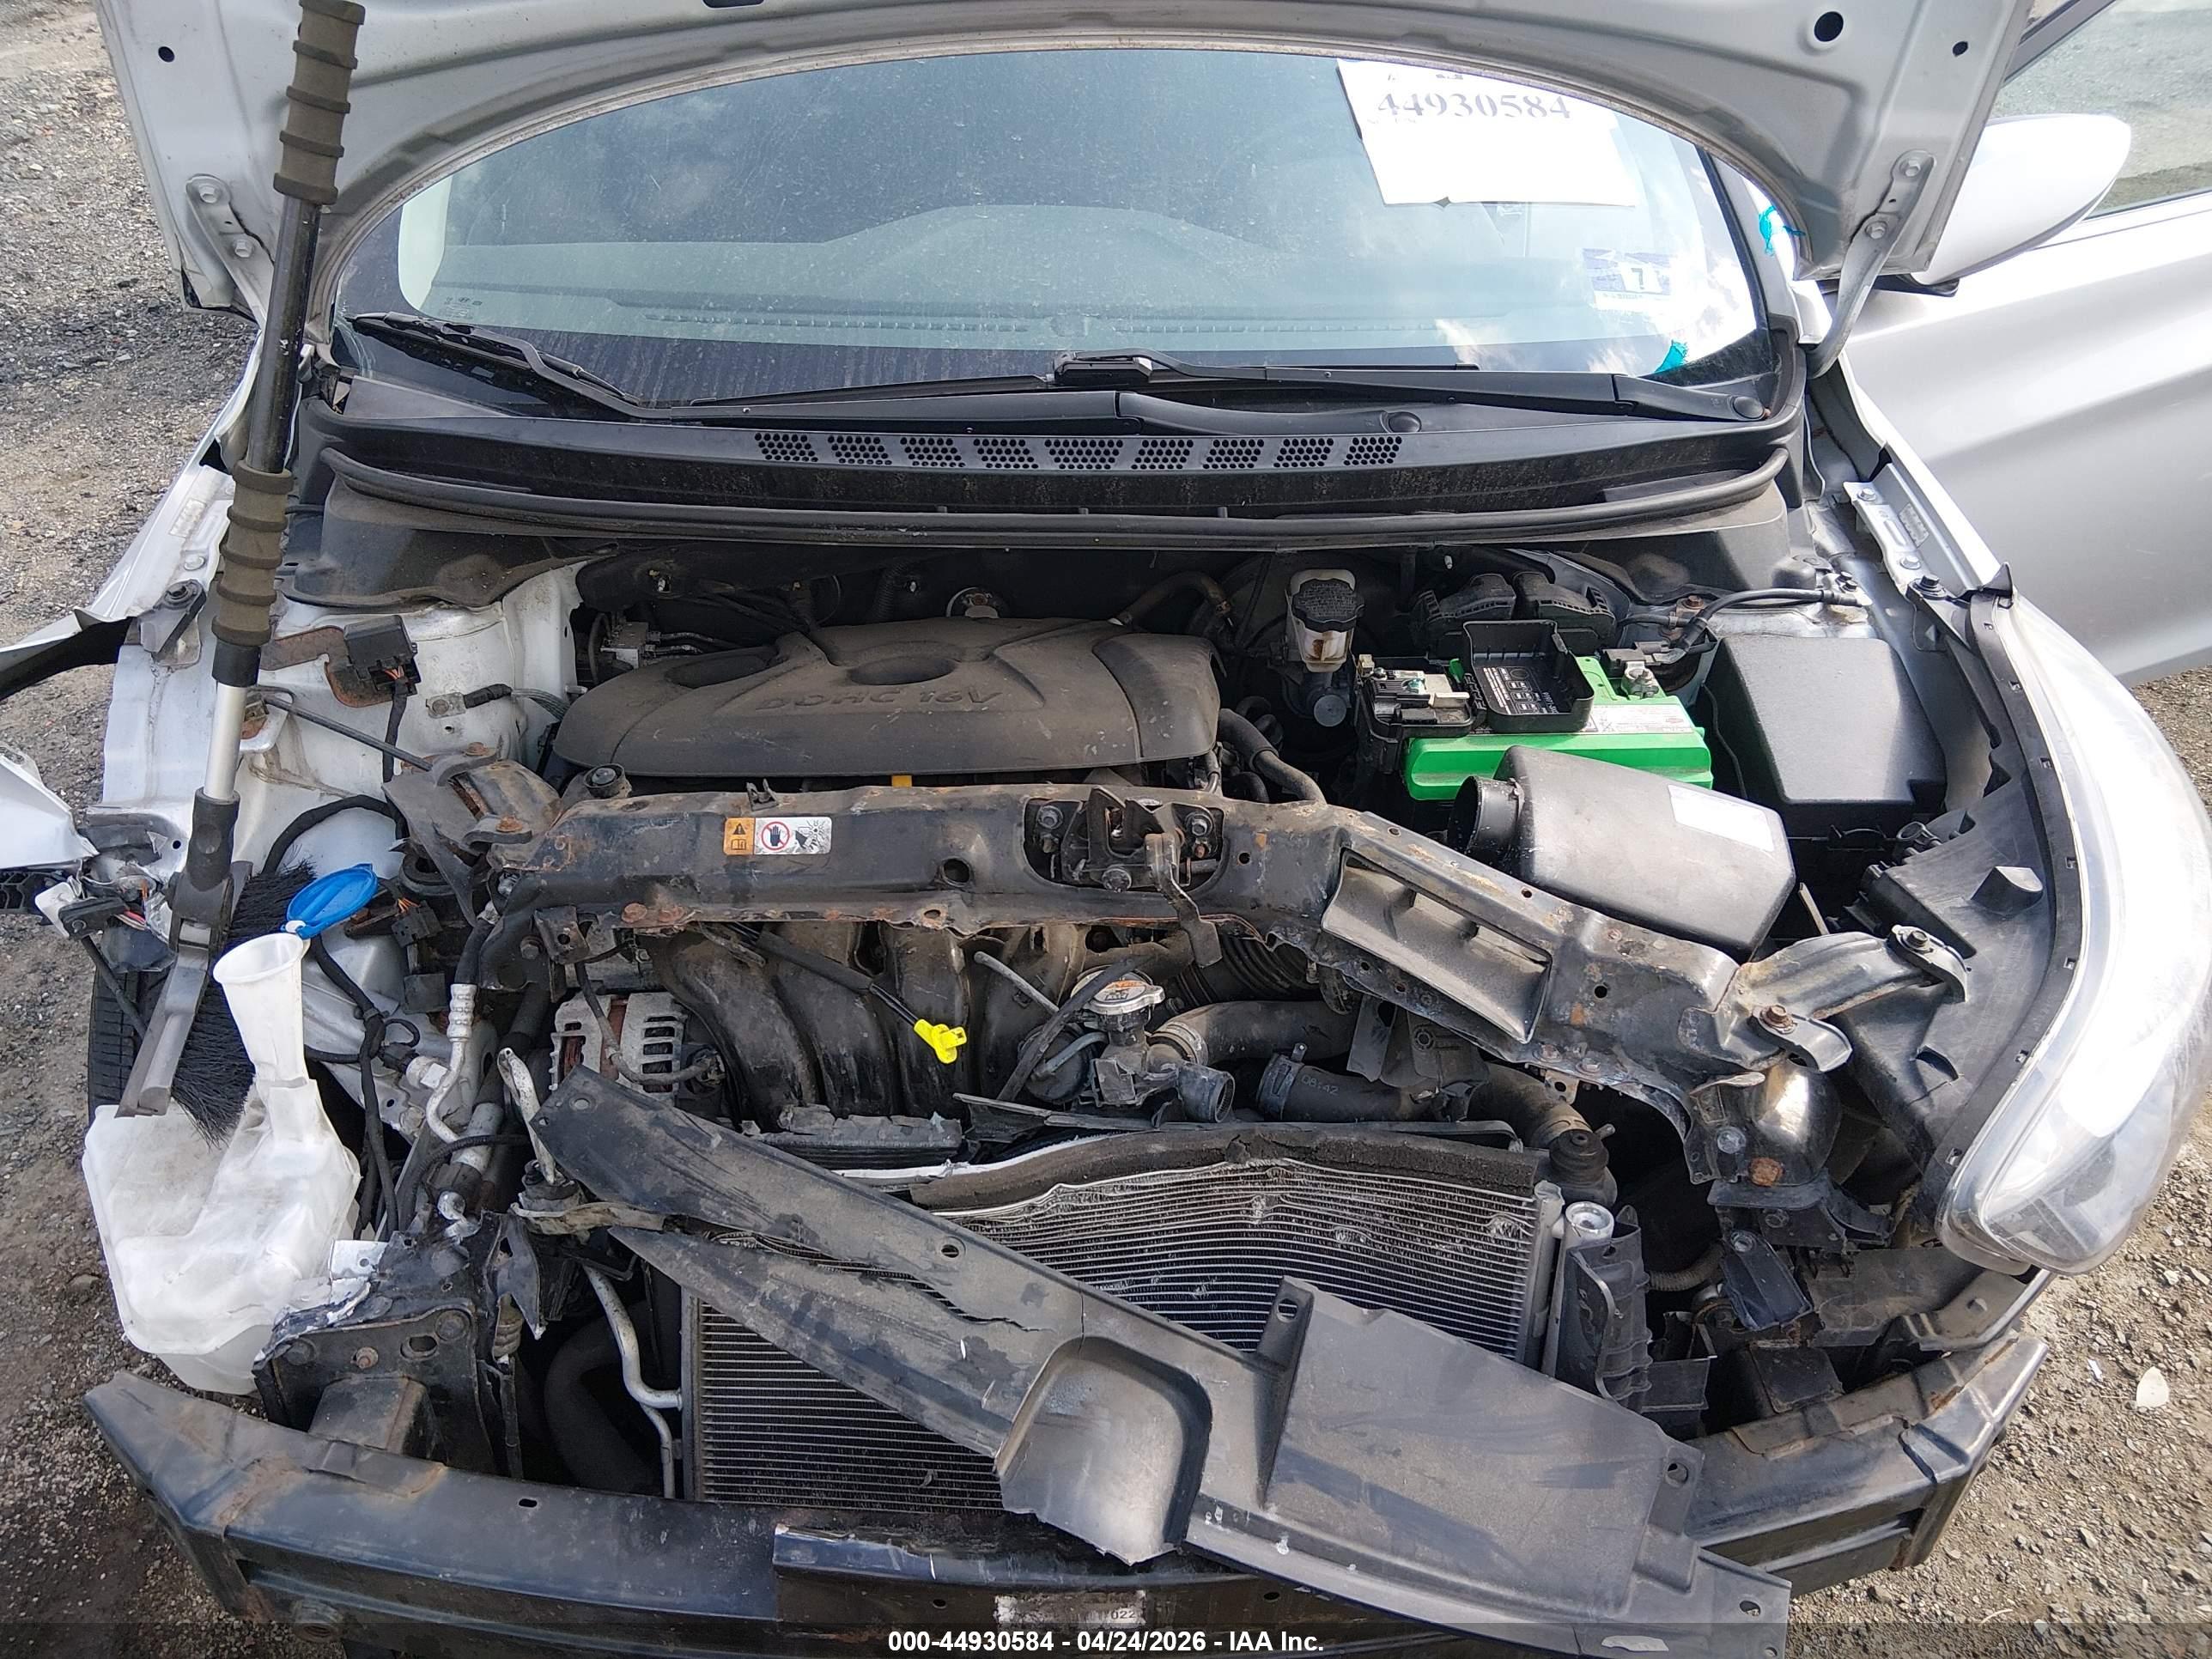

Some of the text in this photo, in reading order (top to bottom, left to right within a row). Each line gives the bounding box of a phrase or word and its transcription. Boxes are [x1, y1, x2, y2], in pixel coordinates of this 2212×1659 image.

[1379, 93, 1571, 118] 44930584
[755, 686, 1004, 711] DOHC 16V
